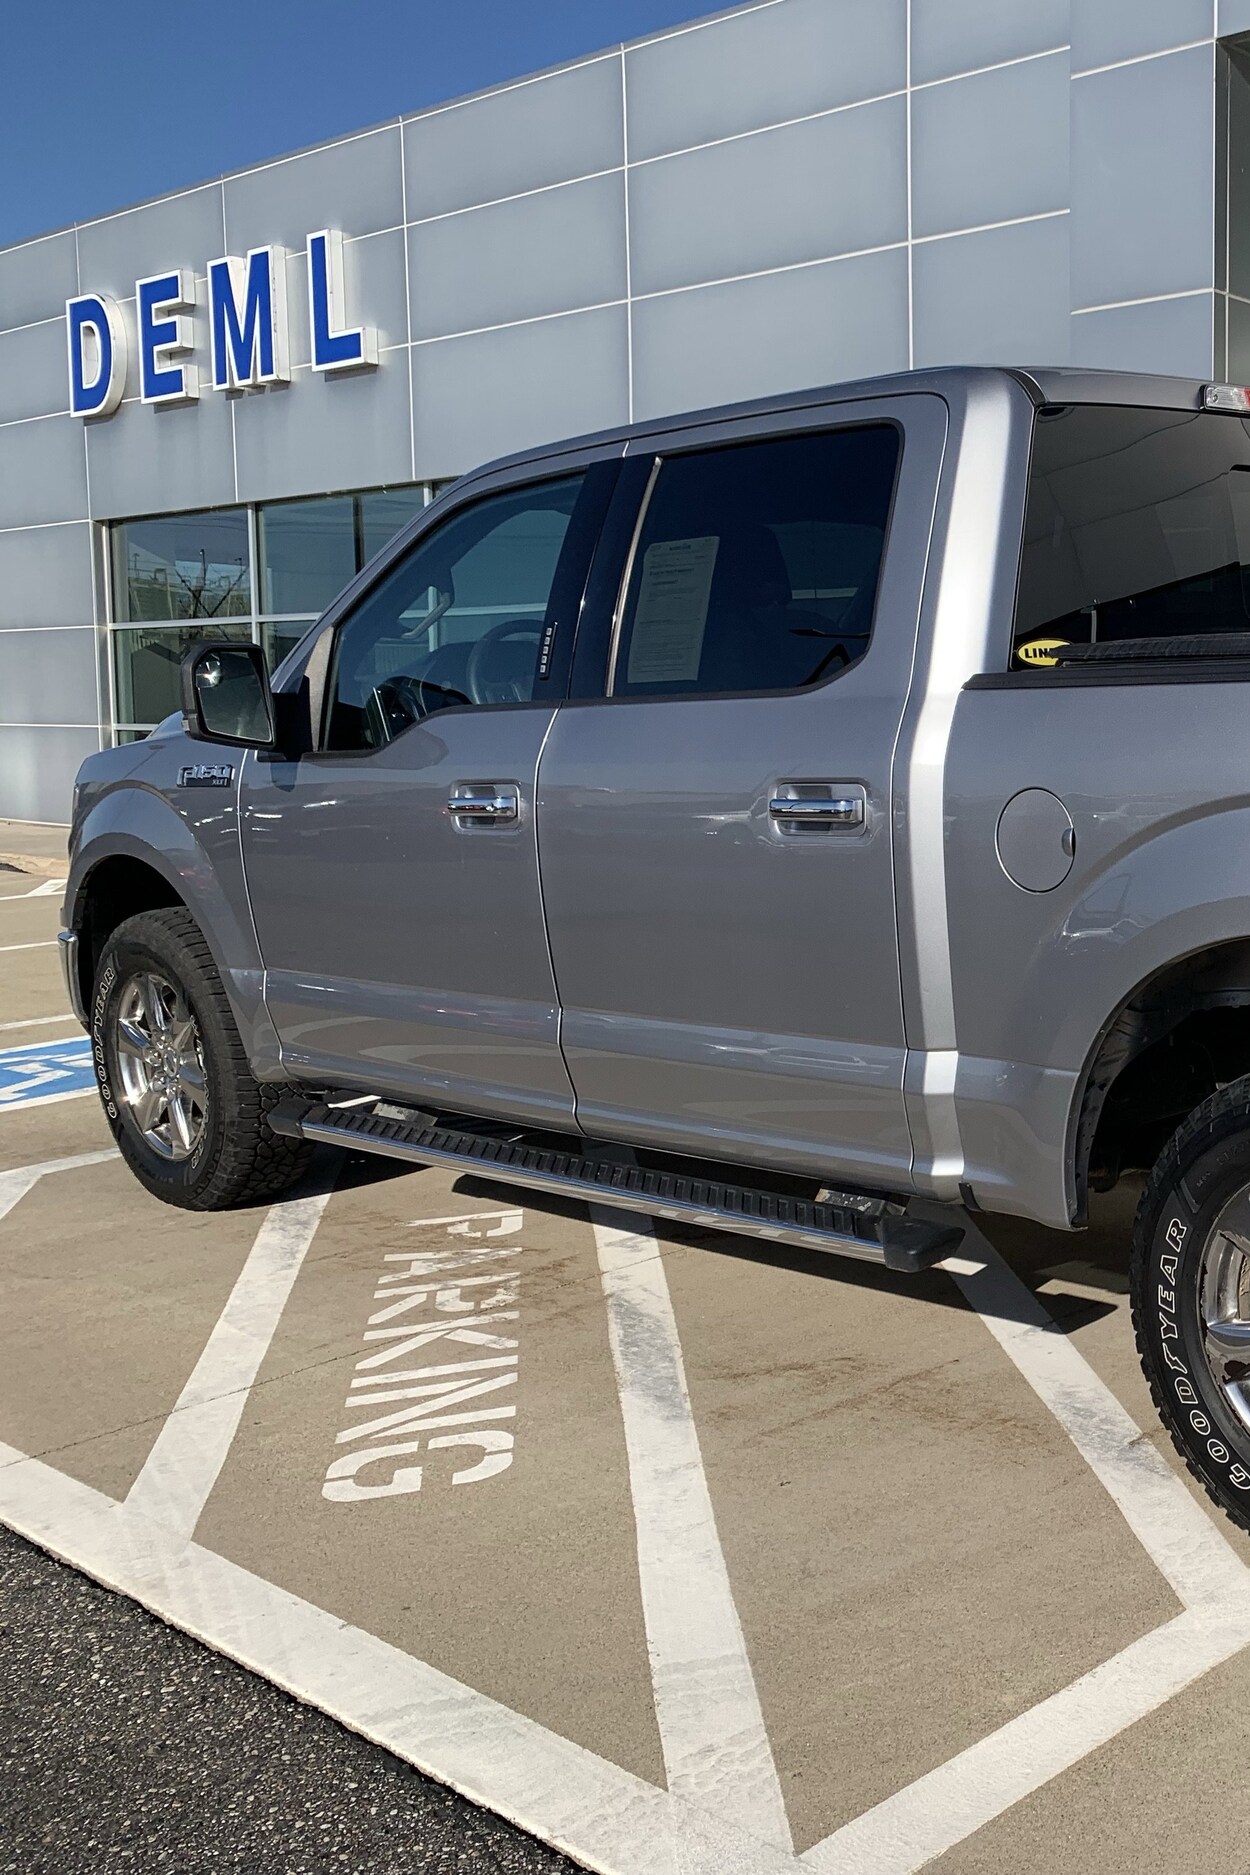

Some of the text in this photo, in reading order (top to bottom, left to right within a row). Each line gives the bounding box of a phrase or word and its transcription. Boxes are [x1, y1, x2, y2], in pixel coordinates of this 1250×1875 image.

[66, 229, 378, 418] DEML
[94, 967, 118, 1119] GOODYEAR
[321, 1209, 524, 1502] PARKING
